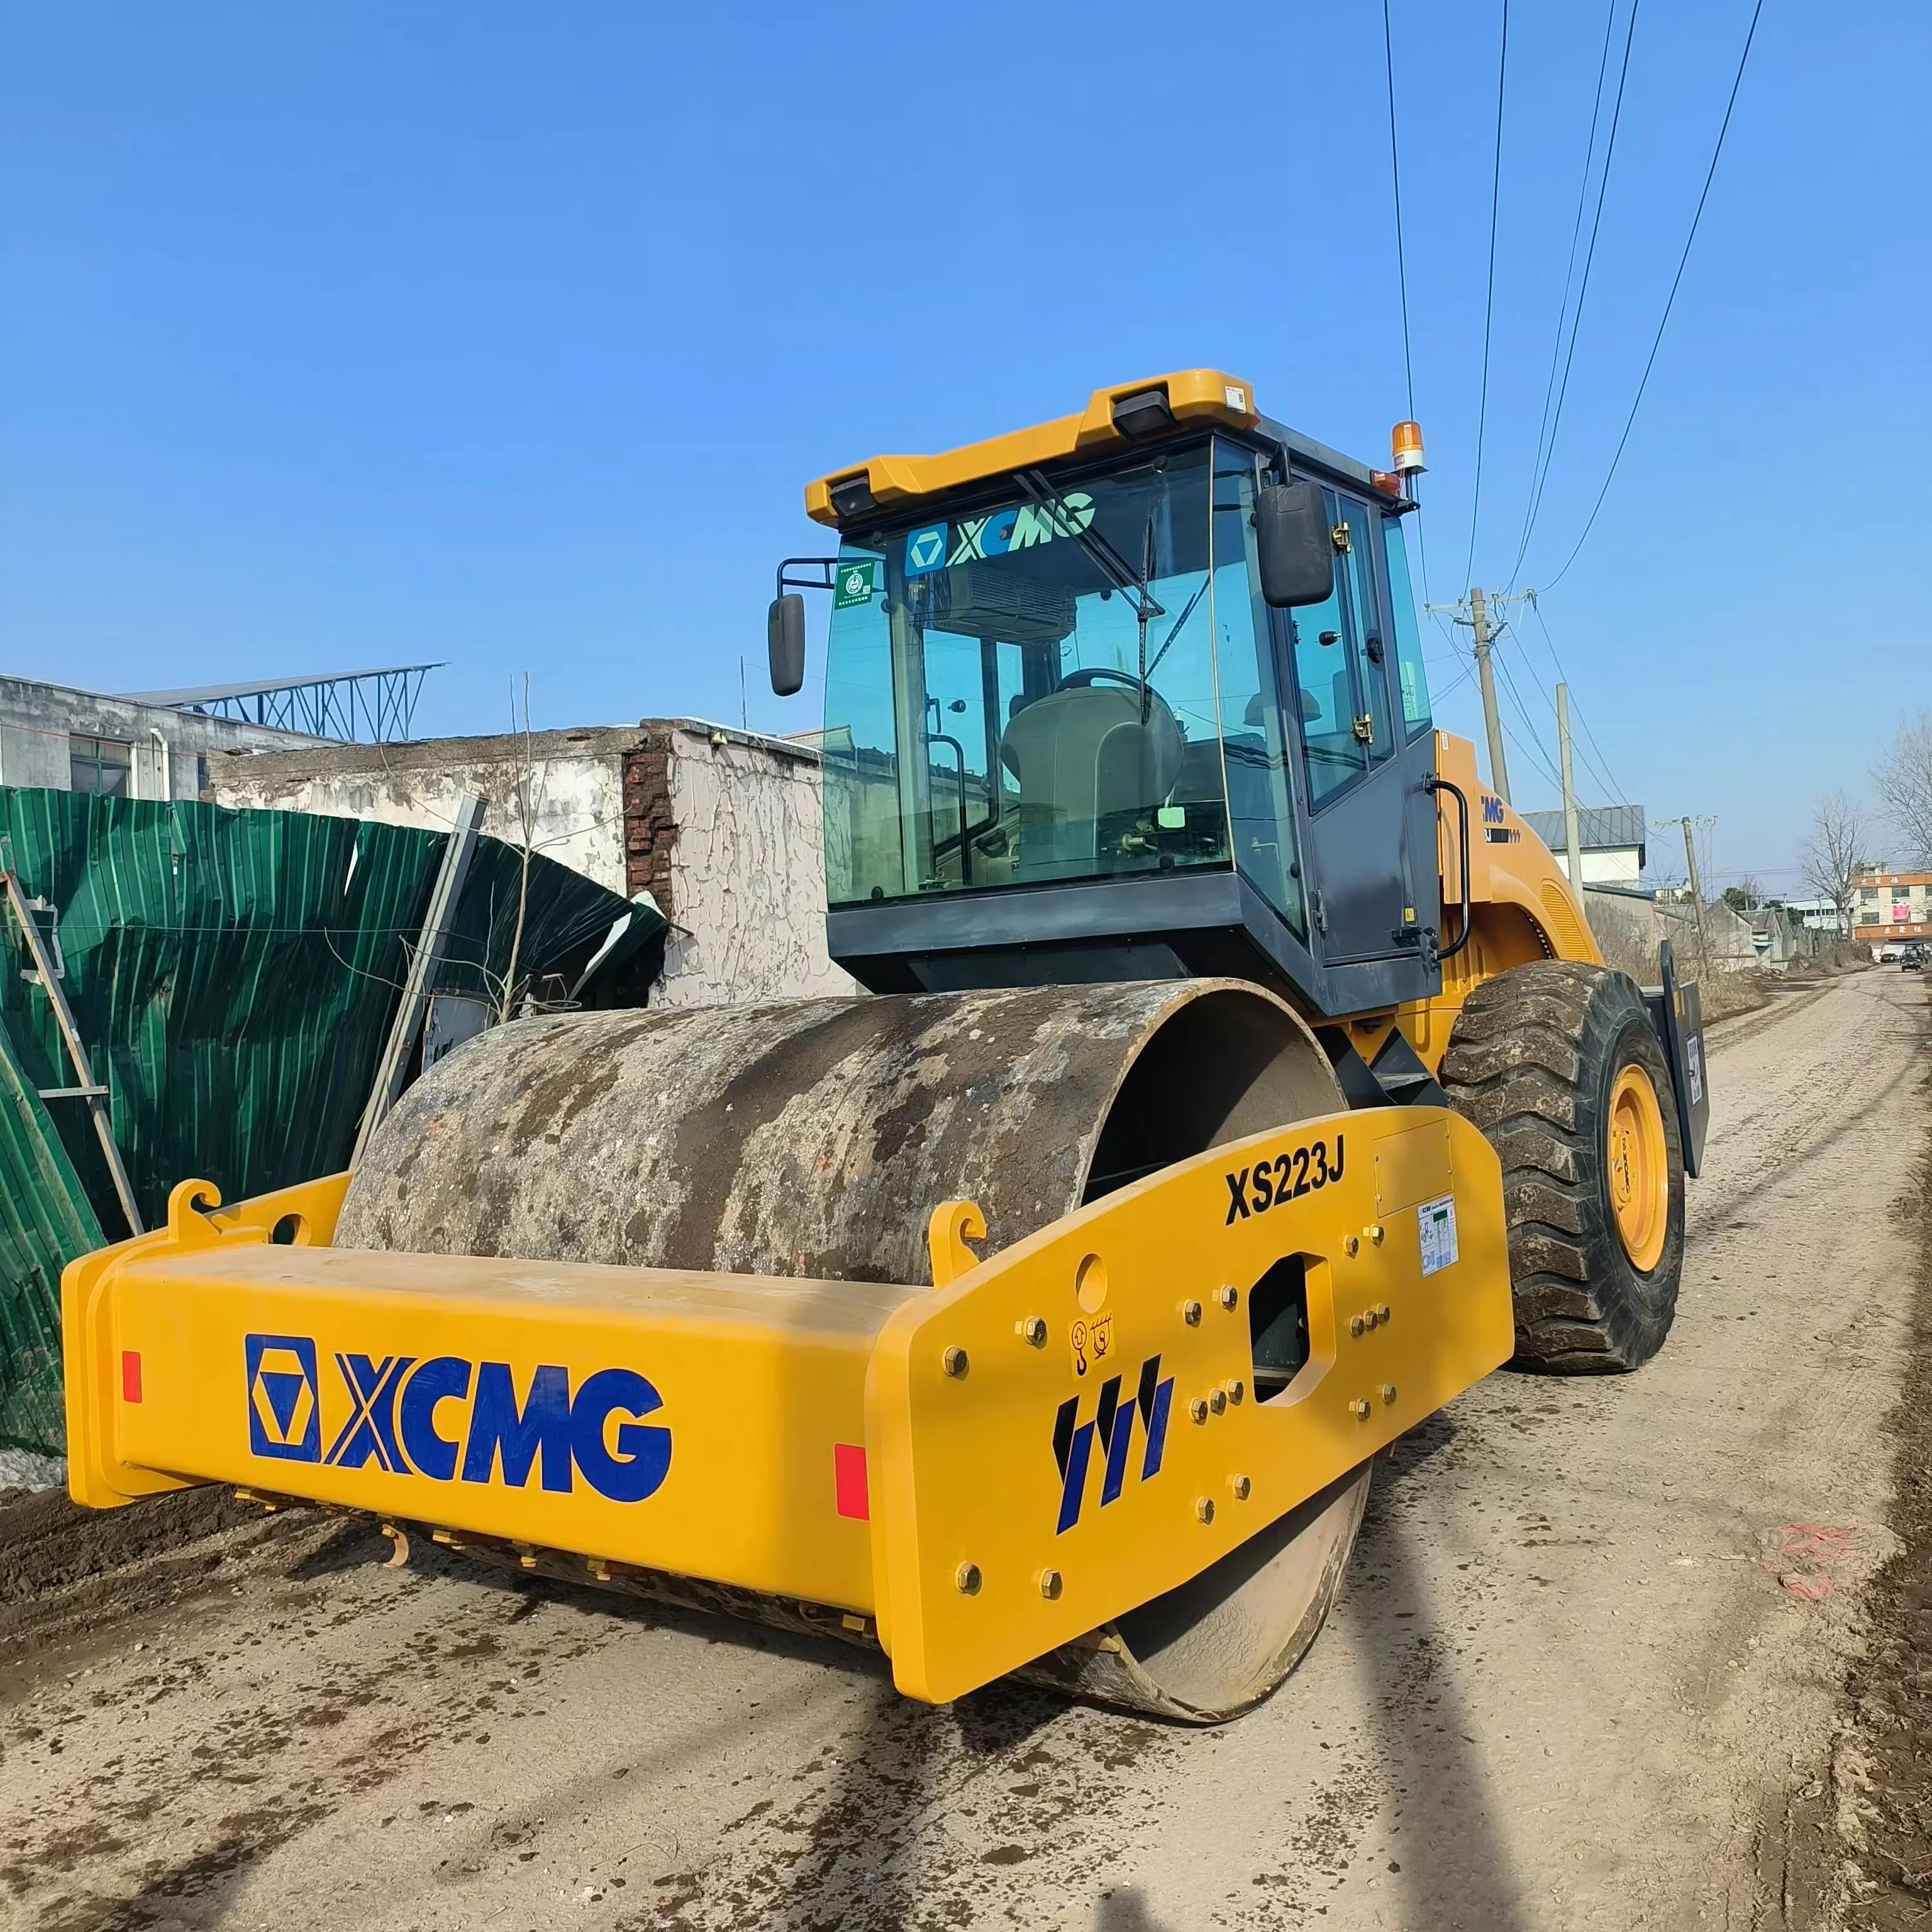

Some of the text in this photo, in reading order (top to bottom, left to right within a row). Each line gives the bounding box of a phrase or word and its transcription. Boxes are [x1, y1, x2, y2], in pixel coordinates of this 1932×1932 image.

[945, 492, 1096, 567] XCMG
[1225, 1134, 1343, 1226] XS223J
[323, 1353, 672, 1502] XCMG
